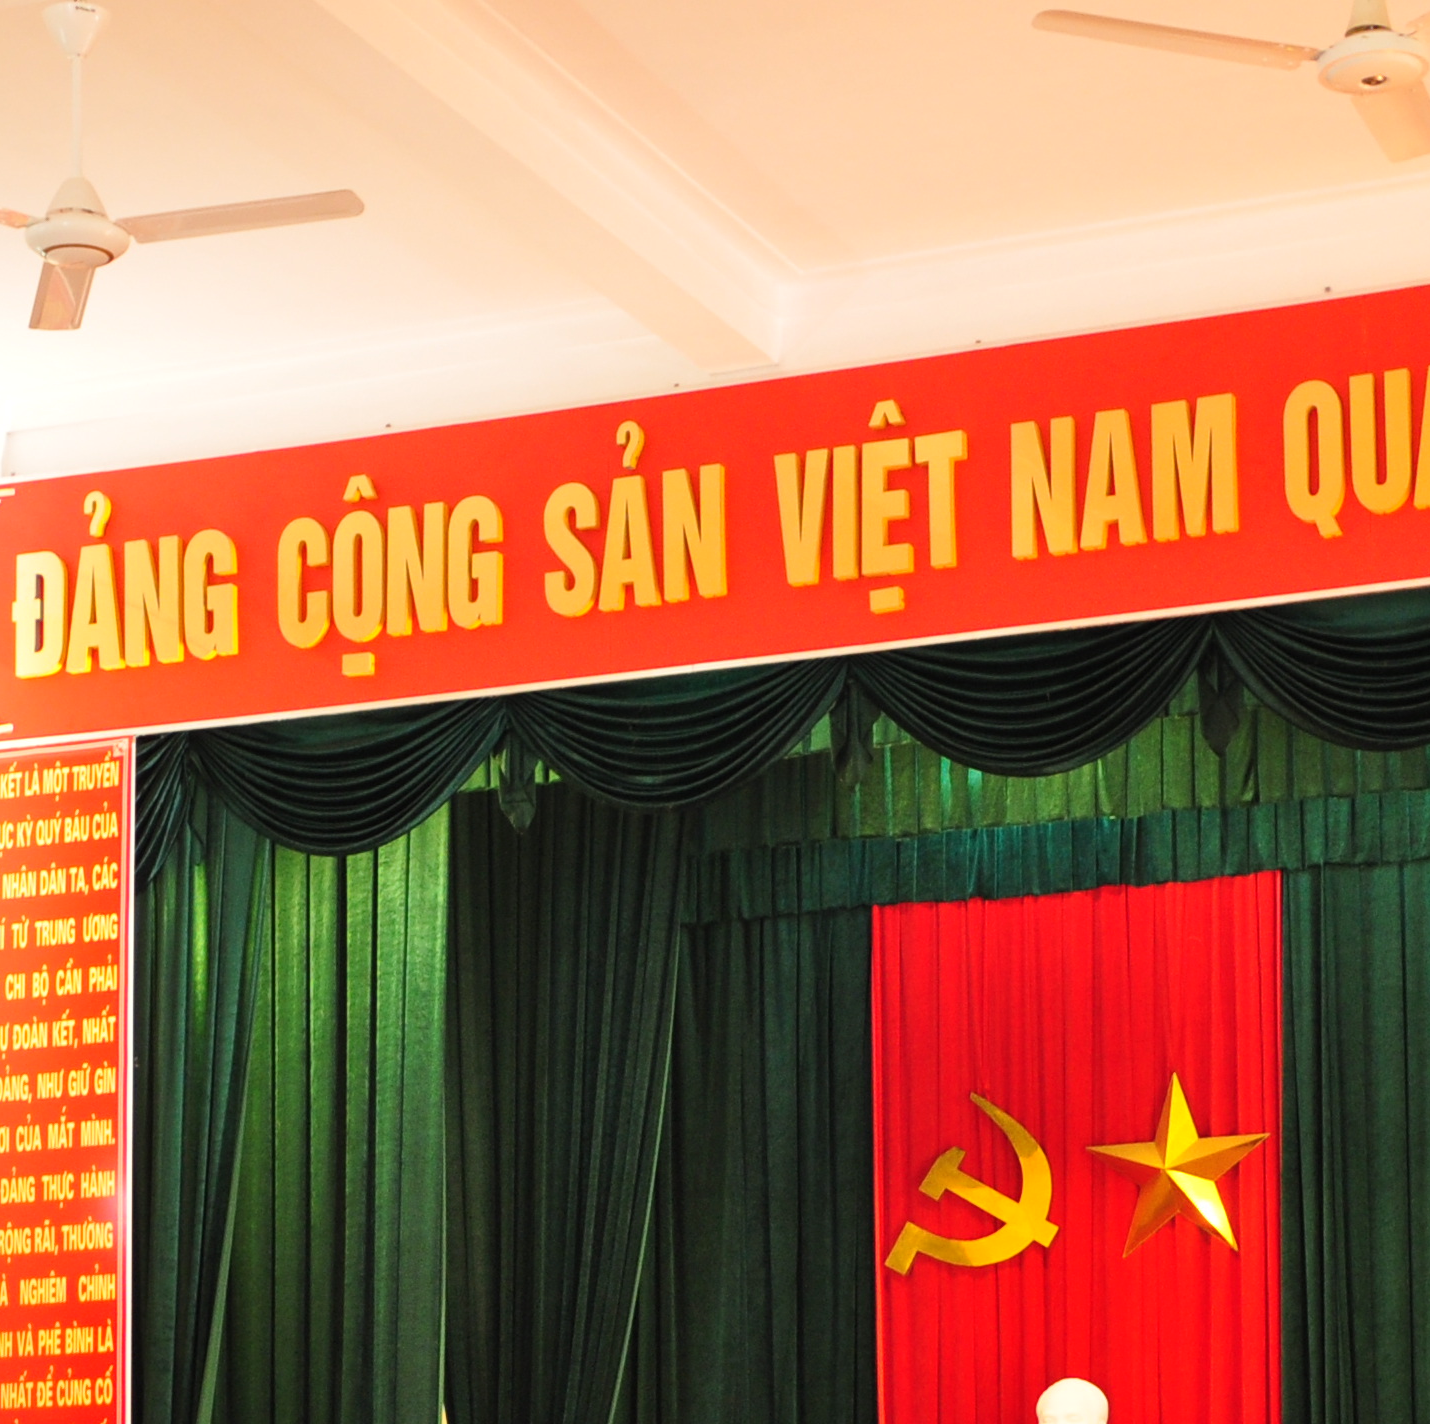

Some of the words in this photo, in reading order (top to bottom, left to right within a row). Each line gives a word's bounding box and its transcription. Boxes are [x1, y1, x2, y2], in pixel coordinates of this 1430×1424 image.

[12, 491, 238, 679] ĐẢNG
[278, 474, 503, 677] CỘNG
[544, 421, 727, 617] SẢN
[774, 400, 967, 614] VIỆT
[1011, 393, 1239, 560] NAM
[0, 762, 22, 799] KẾT
[25, 763, 40, 796] LÀ
[43, 761, 70, 801] MỘT
[64, 809, 89, 843] BÁU
[92, 802, 118, 840] CỦA
[2, 865, 36, 899] NHÂN
[40, 862, 66, 896] DÂN
[92, 857, 118, 891] CÁC
[35, 918, 75, 946] TRUNG
[5, 974, 25, 1000] CHI
[89, 955, 117, 992] PHẢI
[12, 1016, 48, 1050] ĐOÀN
[83, 1006, 116, 1044] NHẤT
[94, 1061, 116, 1094] GÌN
[16, 1114, 41, 1152] CỦA
[0, 1167, 35, 1204] ĐẢNG
[81, 1164, 115, 1198] HÀNH
[20, 1271, 66, 1305] NGHIÊM
[78, 1264, 115, 1302] CHỈNH
[38, 1322, 61, 1355] PHÊ
[65, 1321, 93, 1354] BÌNH
[1, 1371, 34, 1409] NHẤT
[36, 1366, 53, 1407] ĐỂ
[57, 1369, 91, 1406] CỦNG
